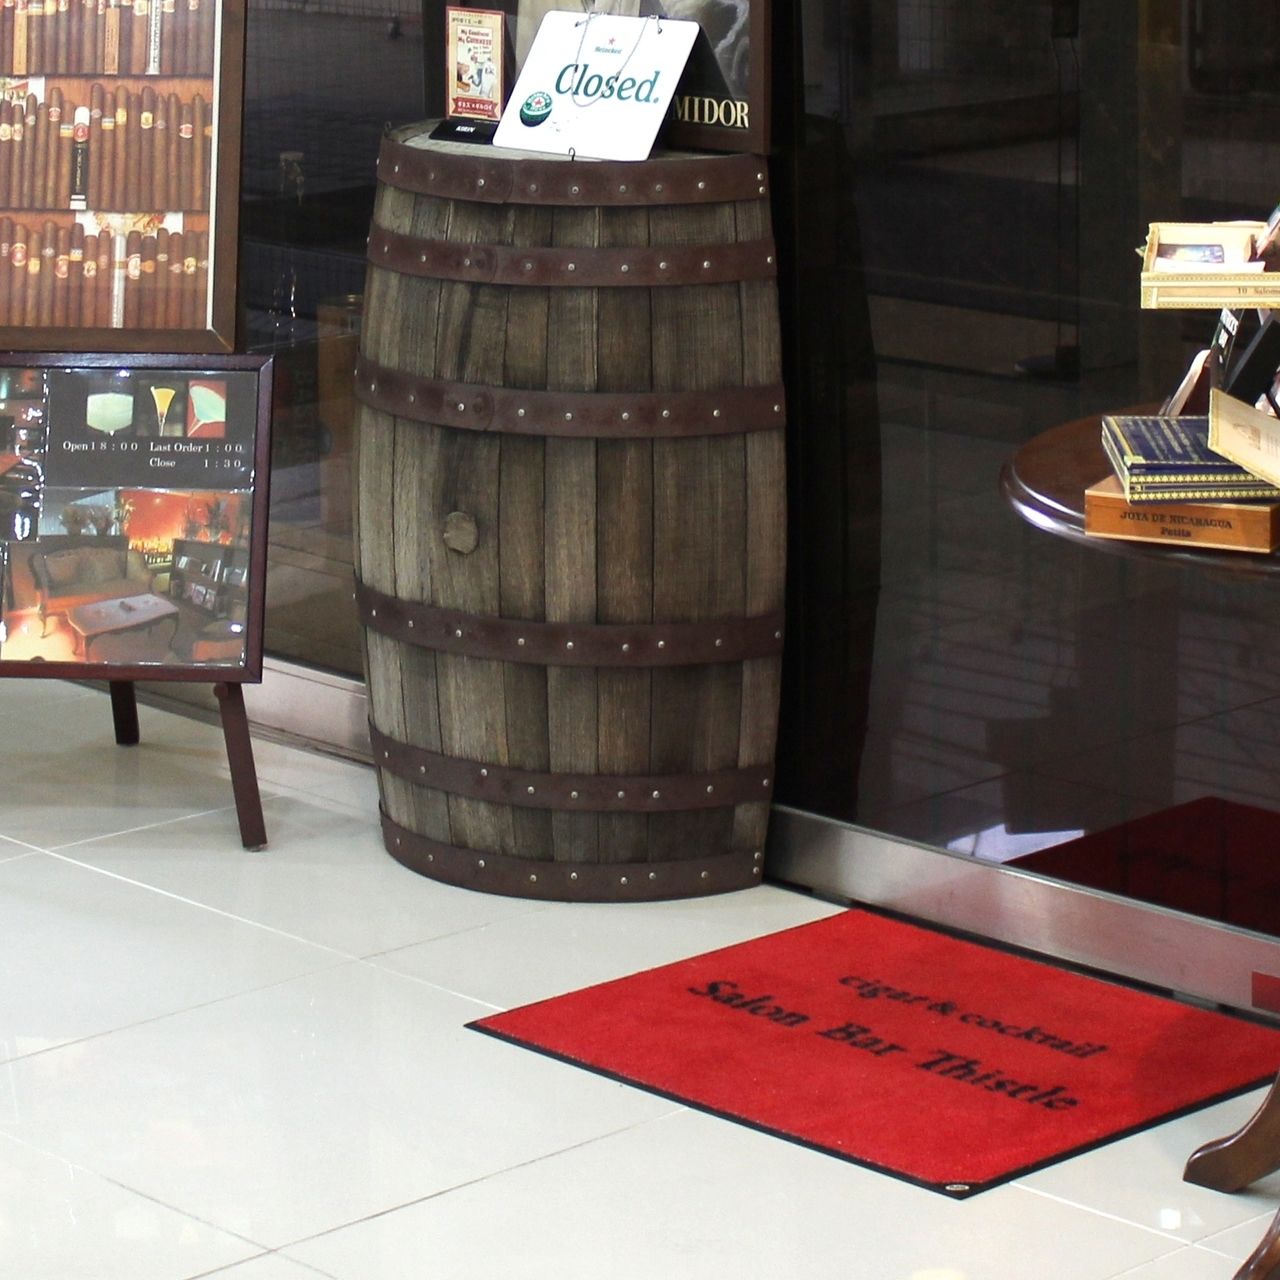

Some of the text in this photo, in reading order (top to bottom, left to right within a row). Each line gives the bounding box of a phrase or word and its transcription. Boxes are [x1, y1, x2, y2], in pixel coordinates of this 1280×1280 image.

[1237, 287, 1248, 295] 10
[62, 440, 89, 452] Open
[149, 441, 171, 452] Last
[174, 441, 203, 453] Order
[149, 457, 176, 468] Close
[1120, 511, 1233, 530] JOYA DE NICARAGUA
[838, 974, 1109, 1060] cigar & cocktail
[687, 979, 1079, 1112] Salon Bar Thistle
